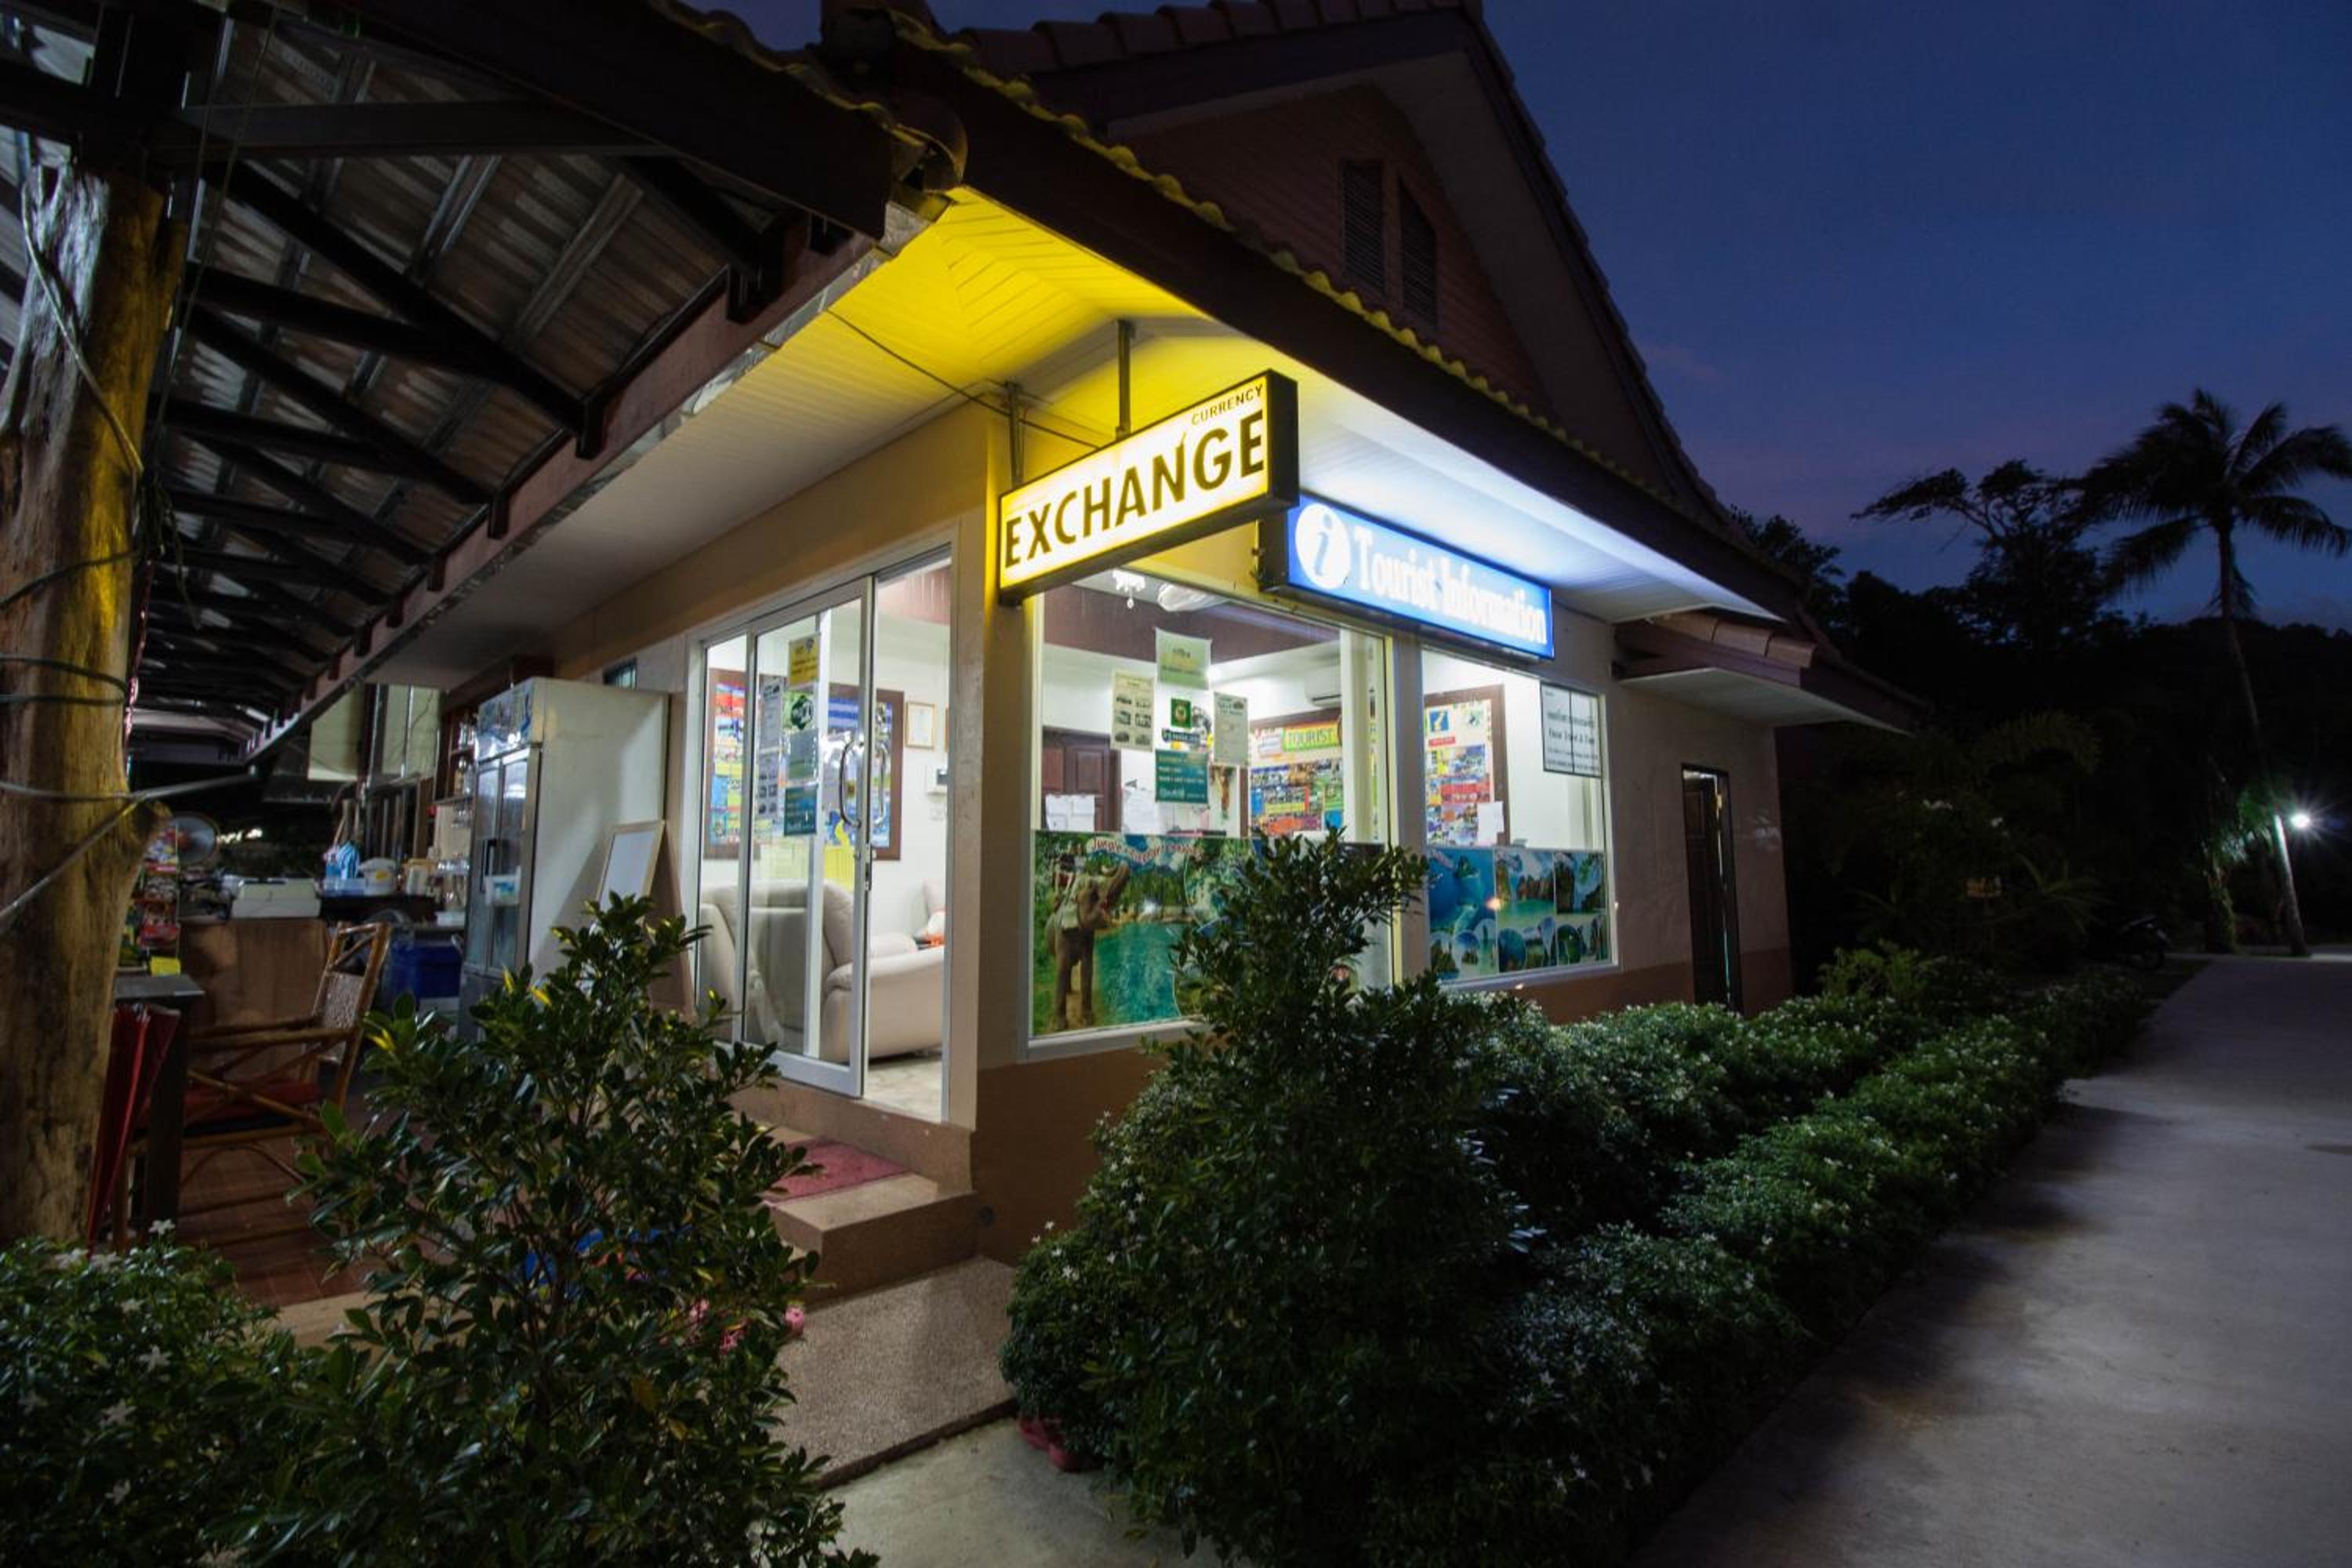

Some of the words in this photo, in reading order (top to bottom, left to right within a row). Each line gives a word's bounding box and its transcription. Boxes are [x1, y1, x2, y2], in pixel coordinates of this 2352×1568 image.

[1191, 383, 1263, 426] CURRENCY
[1005, 409, 1265, 569] EXCHANGE
[1353, 526, 1437, 612] Tourist
[1439, 557, 1548, 644] Information
